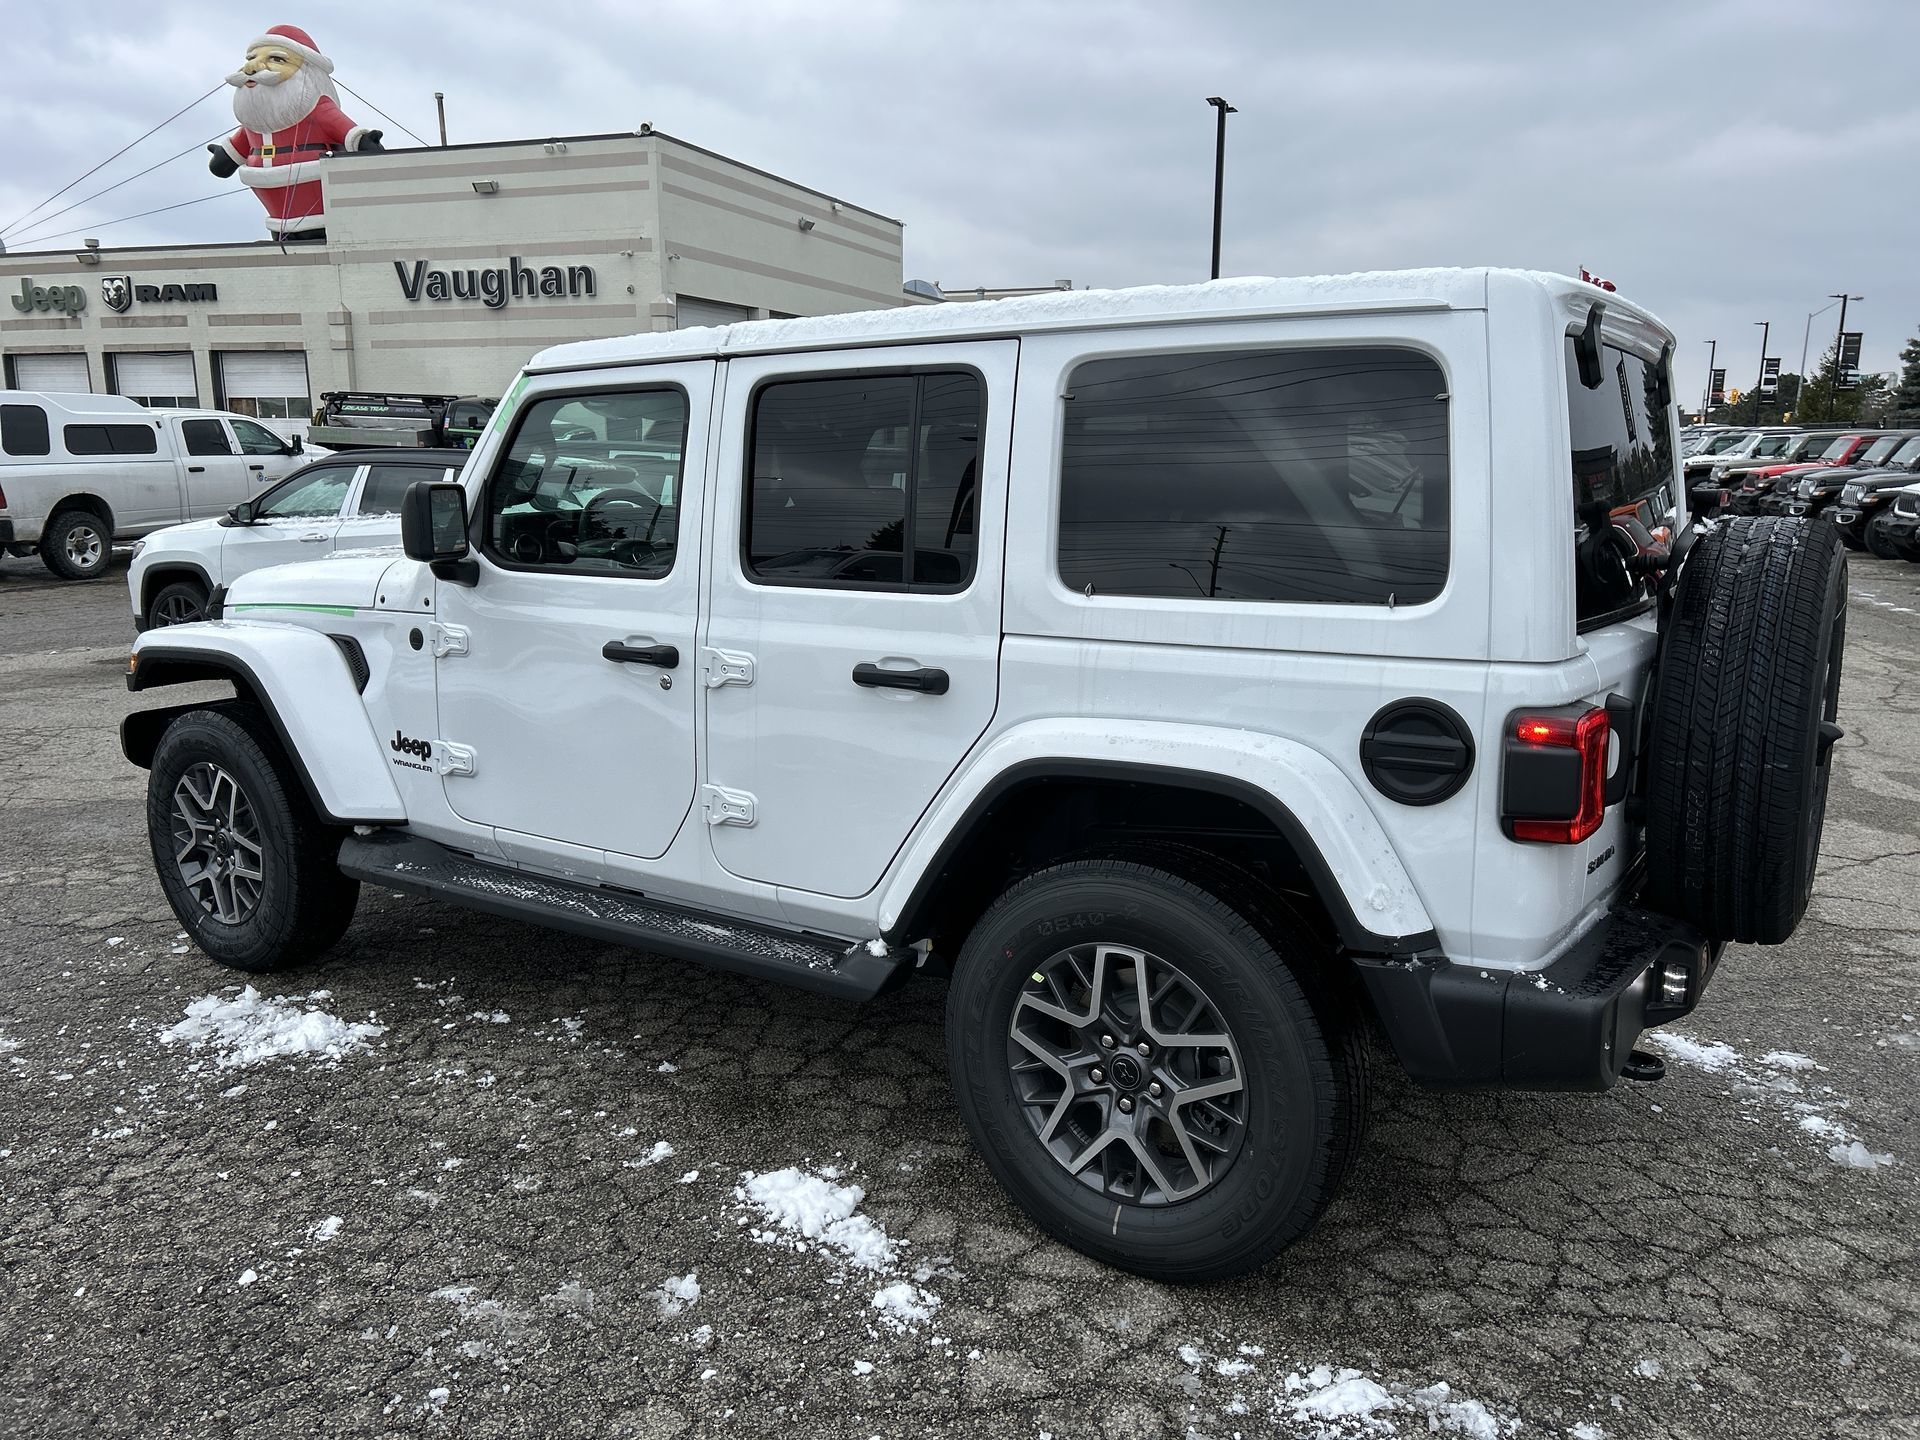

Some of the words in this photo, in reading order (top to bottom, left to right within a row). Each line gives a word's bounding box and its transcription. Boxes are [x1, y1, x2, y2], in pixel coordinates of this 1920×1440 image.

[135, 284, 217, 302] RAM
[394, 255, 597, 309] Vaughan
[11, 277, 87, 318] Jeep
[341, 404, 368, 412] GREASE
[391, 730, 431, 761] Jeep
[392, 758, 433, 773] WRANGLER
